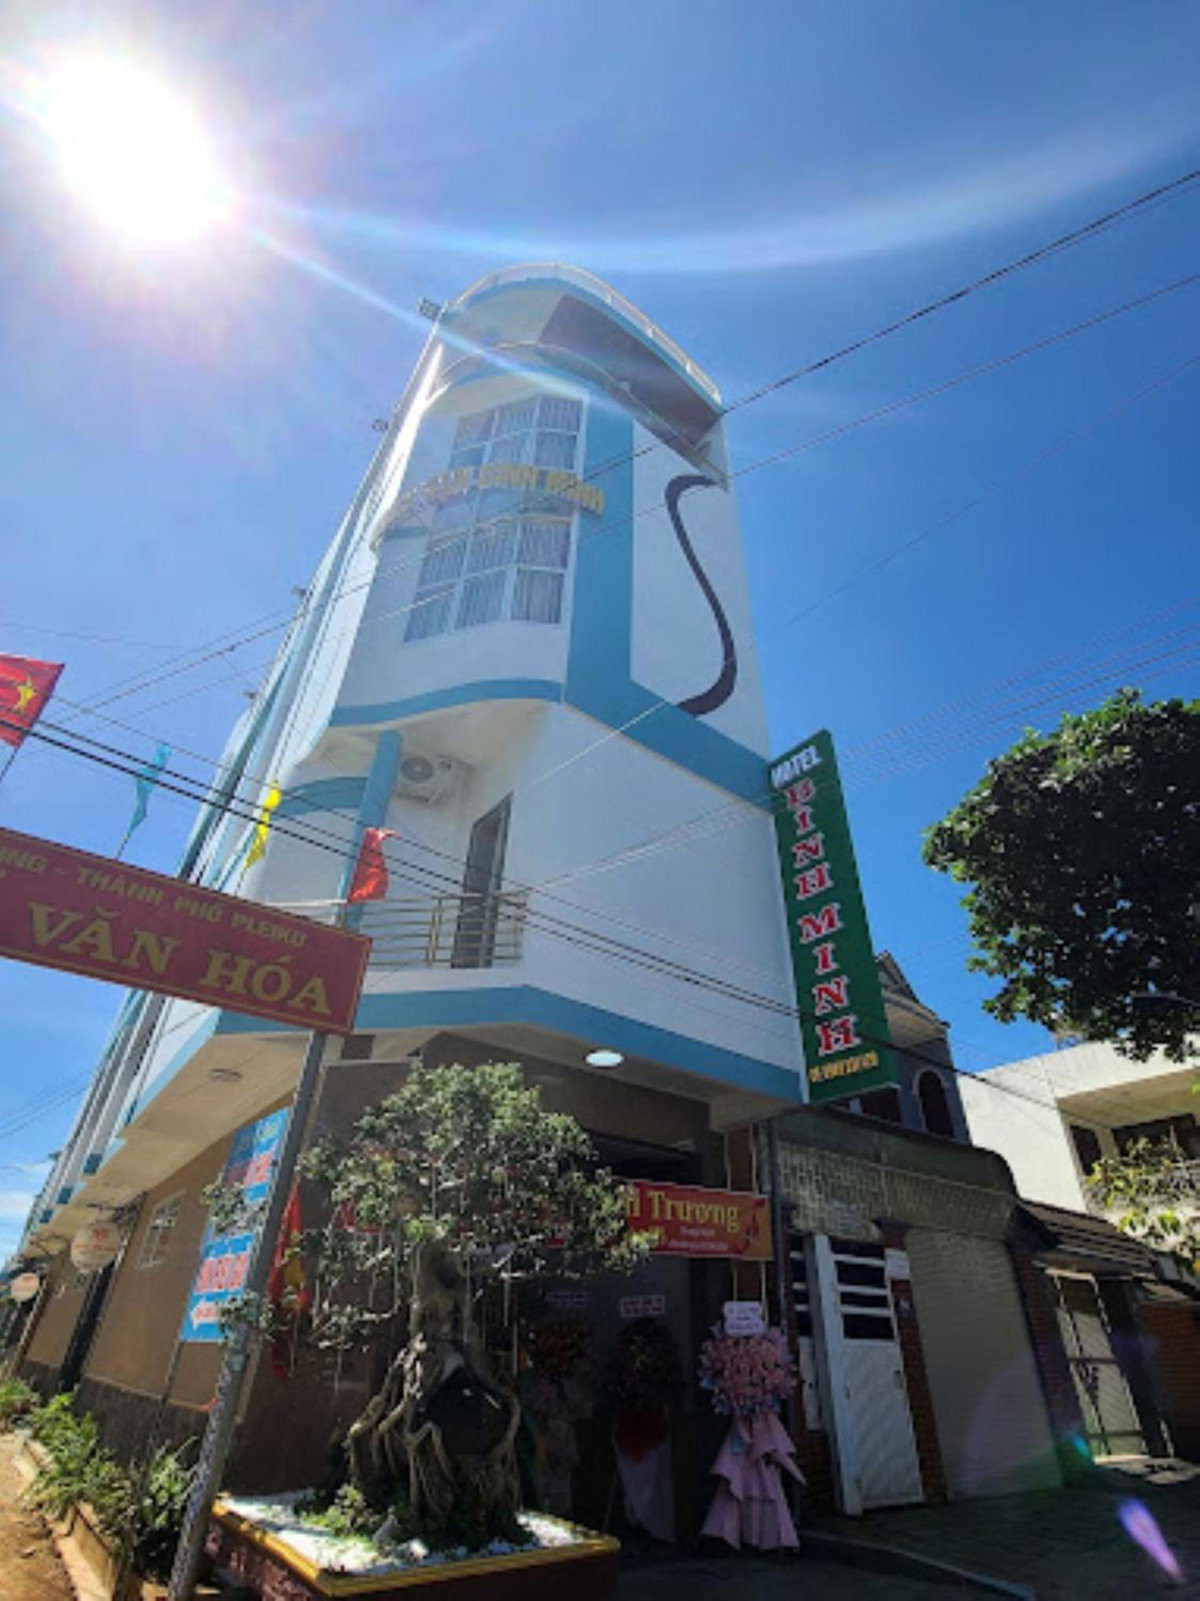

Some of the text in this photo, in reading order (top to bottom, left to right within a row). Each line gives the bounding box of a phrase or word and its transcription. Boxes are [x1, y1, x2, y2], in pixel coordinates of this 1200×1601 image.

[27, 901, 333, 1016] VĂN HÓA
[231, 912, 309, 949] PLEIKU
